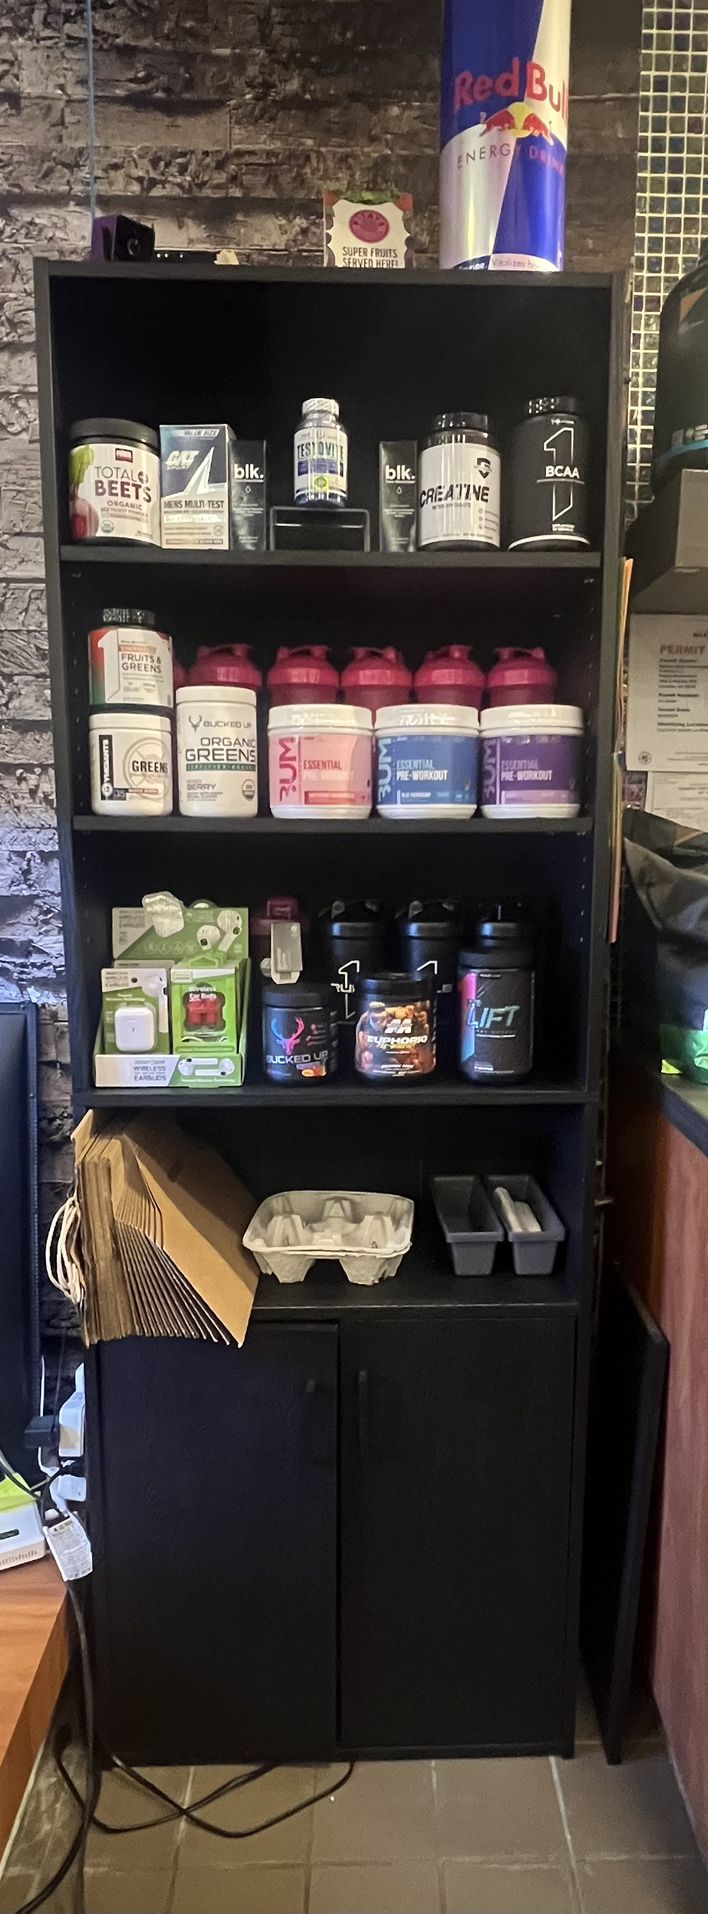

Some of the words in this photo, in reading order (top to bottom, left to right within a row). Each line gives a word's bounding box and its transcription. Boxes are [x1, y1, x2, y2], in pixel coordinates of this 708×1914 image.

[454, 57, 519, 112] Red
[342, 246, 368, 257] SUPER
[370, 248, 398, 259] FRUITS
[94, 465, 138, 483] TOTAL
[234, 463, 264, 479] blk.
[385, 464, 416, 480] blk.
[545, 465, 580, 479] BCAA
[94, 479, 152, 504] BEETS
[420, 482, 490, 509] CREATINE
[107, 500, 143, 511] ORGANIC
[660, 645, 705, 655] PERMIT
[121, 653, 155, 664] FRUITS
[121, 662, 162, 674] GREENS
[203, 720, 242, 728] BUCKED
[185, 748, 256, 763] GREENS
[132, 760, 169, 775] GREENS
[303, 759, 342, 770] ESSENTIAL
[397, 759, 433, 770] ESSENTIAL
[187, 783, 216, 791] BERRY
[467, 1002, 521, 1029] LIFT
